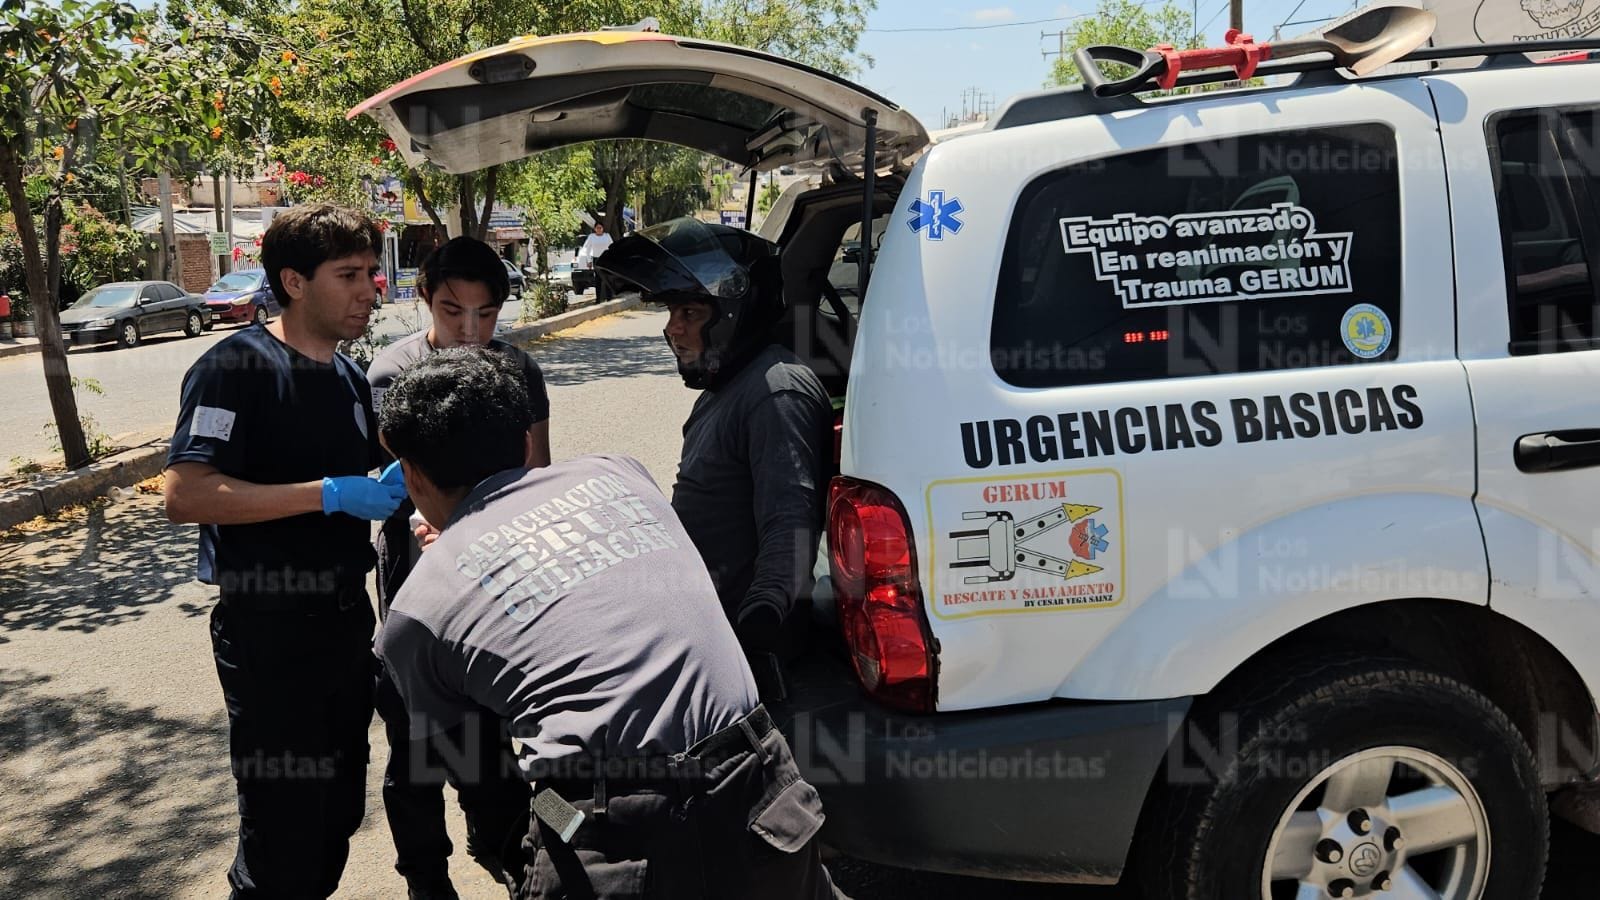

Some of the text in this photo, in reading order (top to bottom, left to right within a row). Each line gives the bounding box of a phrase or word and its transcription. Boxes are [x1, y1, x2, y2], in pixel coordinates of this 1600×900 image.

[1069, 210, 1307, 247] Equipo avanzado
[1100, 238, 1344, 272] En reanimación y
[1121, 265, 1344, 300] Trauma GERUM
[960, 384, 1424, 469] URGENCIAS BASICAS
[983, 481, 1067, 504] GERUM
[455, 473, 633, 579] CAPACITACION
[504, 522, 678, 623] CULIACAN
[943, 583, 1114, 606] RESCATE Y SALVAMENTO
[1024, 600, 1036, 608] BY
[1037, 598, 1064, 607] CESAR
[1066, 597, 1087, 605] VEGA
